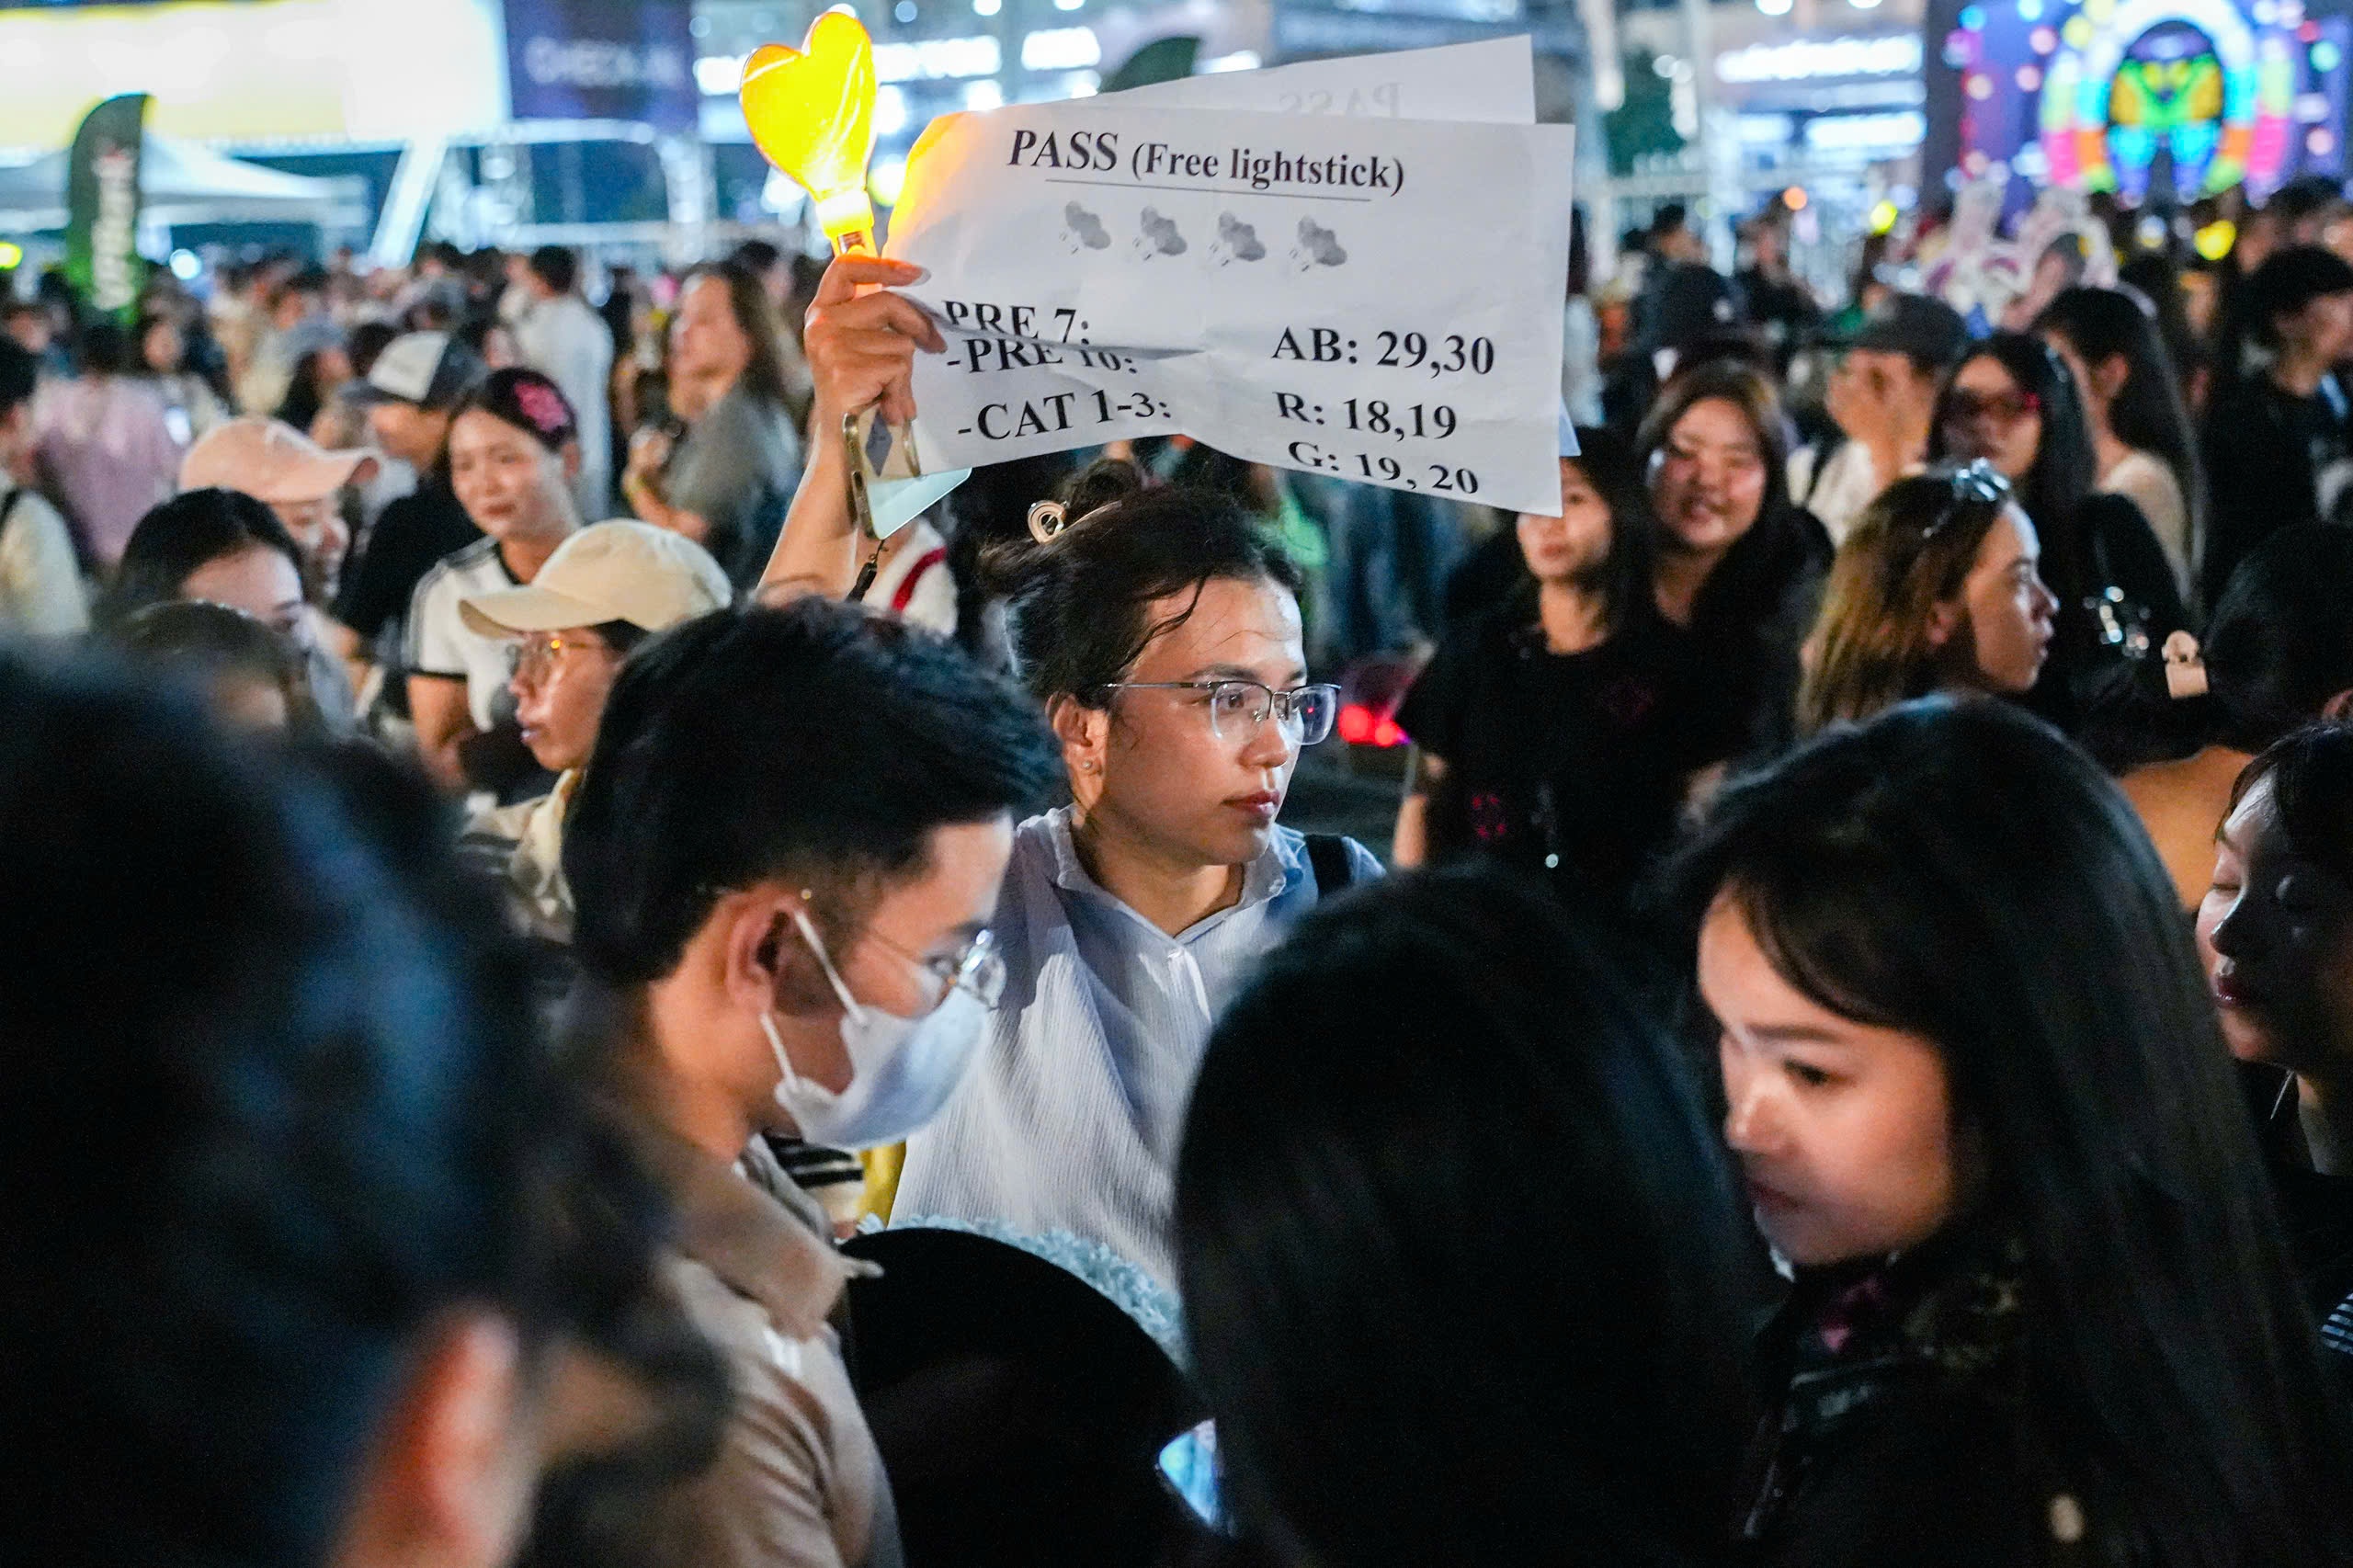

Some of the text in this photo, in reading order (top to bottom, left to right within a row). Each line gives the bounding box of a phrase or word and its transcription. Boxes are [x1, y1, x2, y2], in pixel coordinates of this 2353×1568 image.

[1007, 130, 1404, 198] PASS (Free lightstick)
[1053, 308, 1090, 346] 7:
[1271, 325, 1495, 379] AB: 29,30
[946, 337, 1063, 374] -PRE
[958, 389, 1172, 441] -CAT 1-3:
[1272, 392, 1457, 442] R: 18,19
[1288, 441, 1340, 472] G:
[1428, 464, 1479, 494] 20
